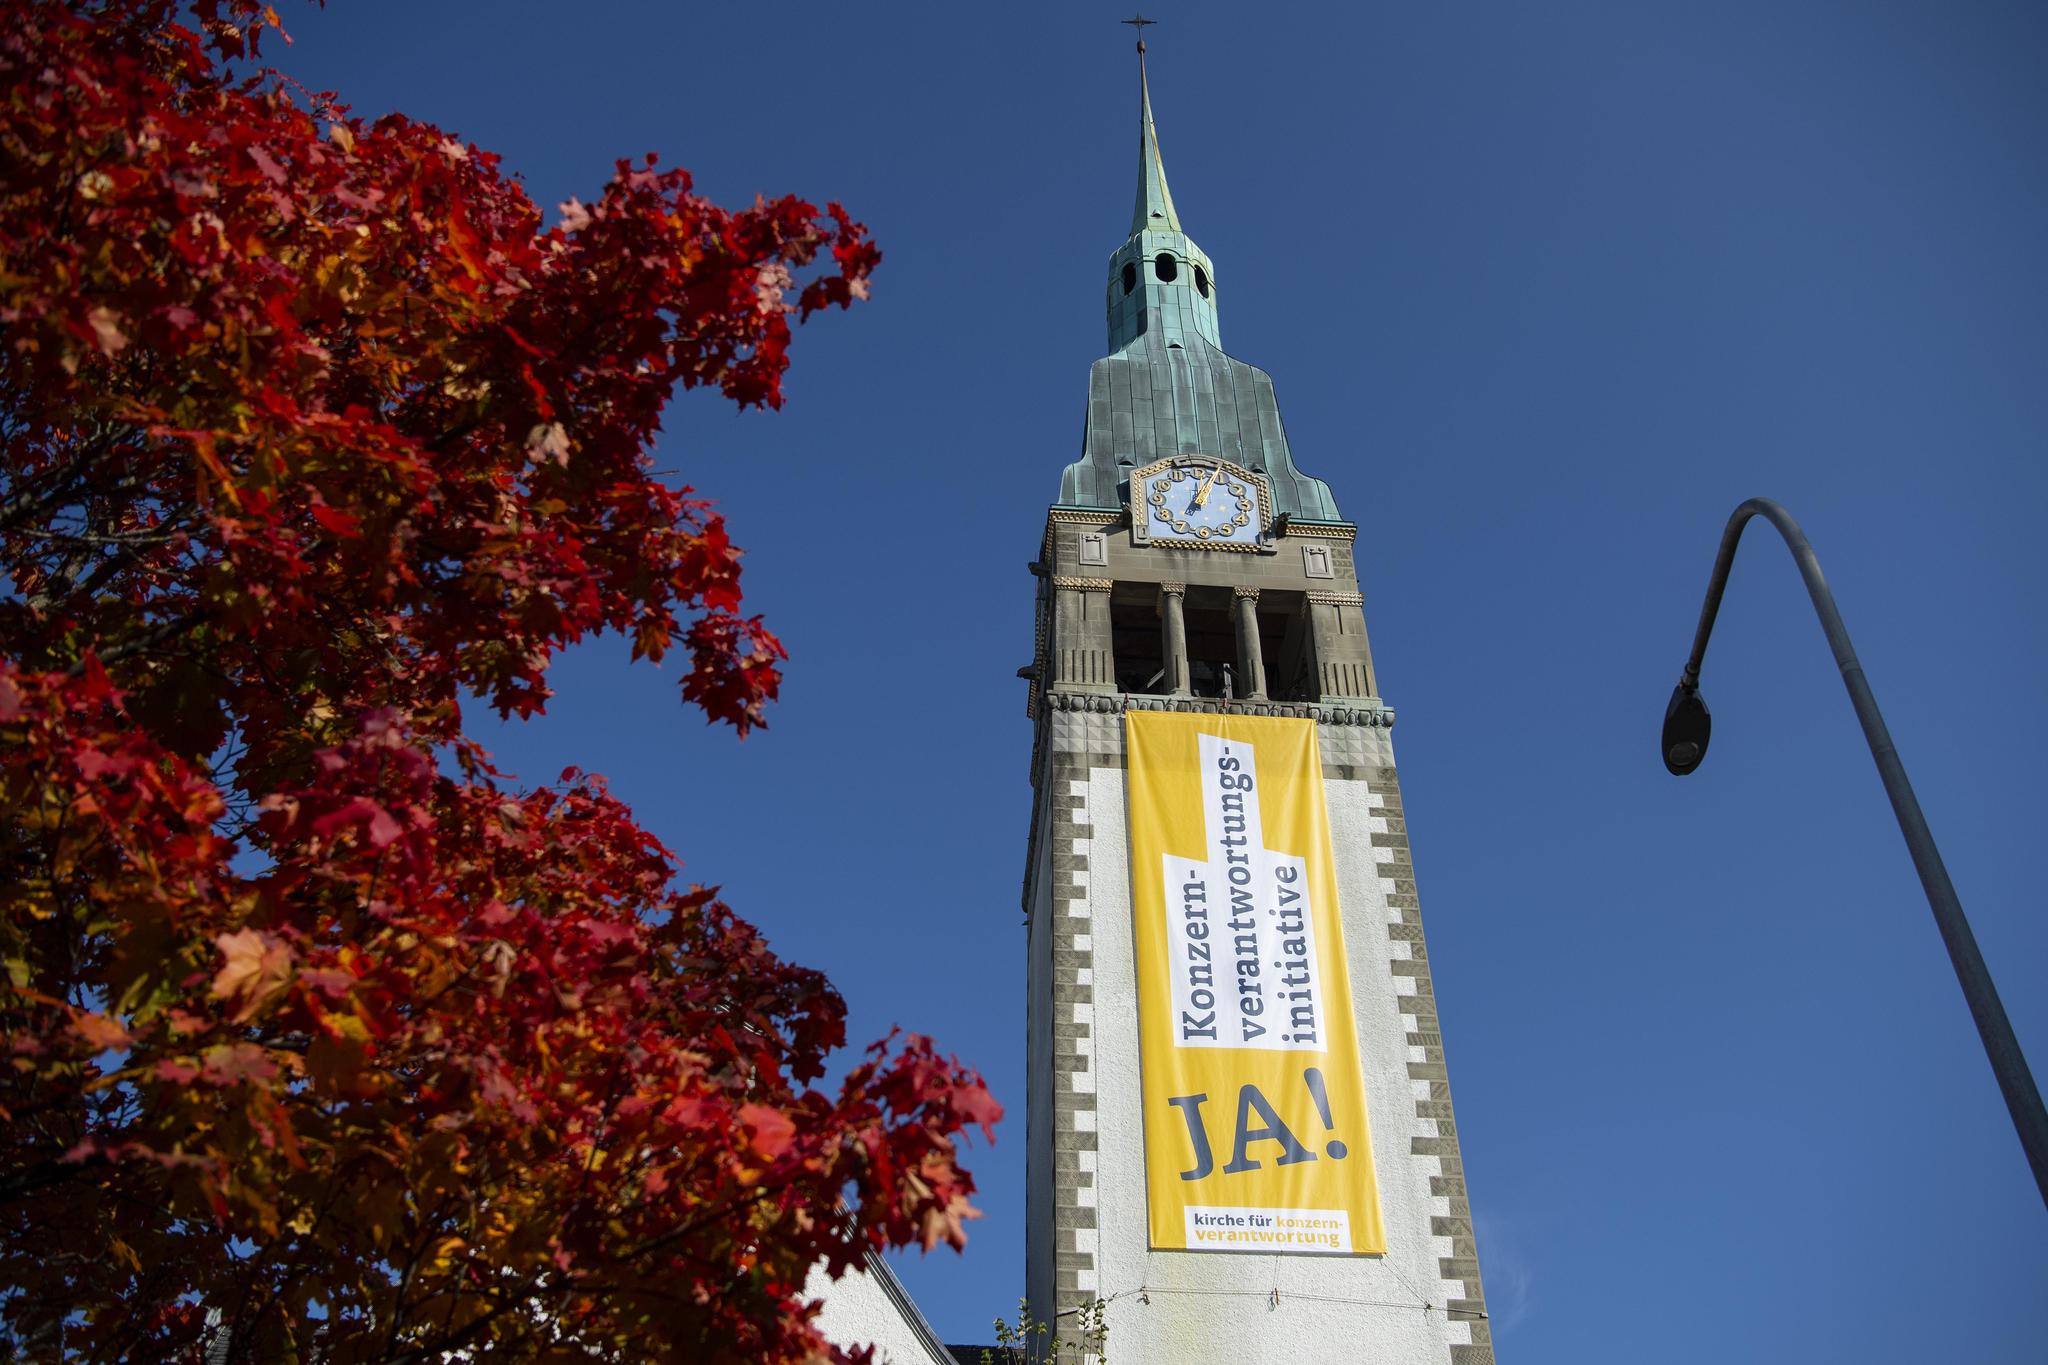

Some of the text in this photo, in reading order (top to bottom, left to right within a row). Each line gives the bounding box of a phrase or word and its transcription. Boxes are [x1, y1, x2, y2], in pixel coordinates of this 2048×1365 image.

[1183, 869, 1217, 1041] Konzern-
[1217, 746, 1267, 1041] verantwortungs-
[1268, 865, 1317, 1044] initiative
[1167, 1067, 1348, 1181] JA!
[1194, 1213, 1344, 1230] kirche für konzern-
[1195, 1229, 1340, 1248] verantwortung
